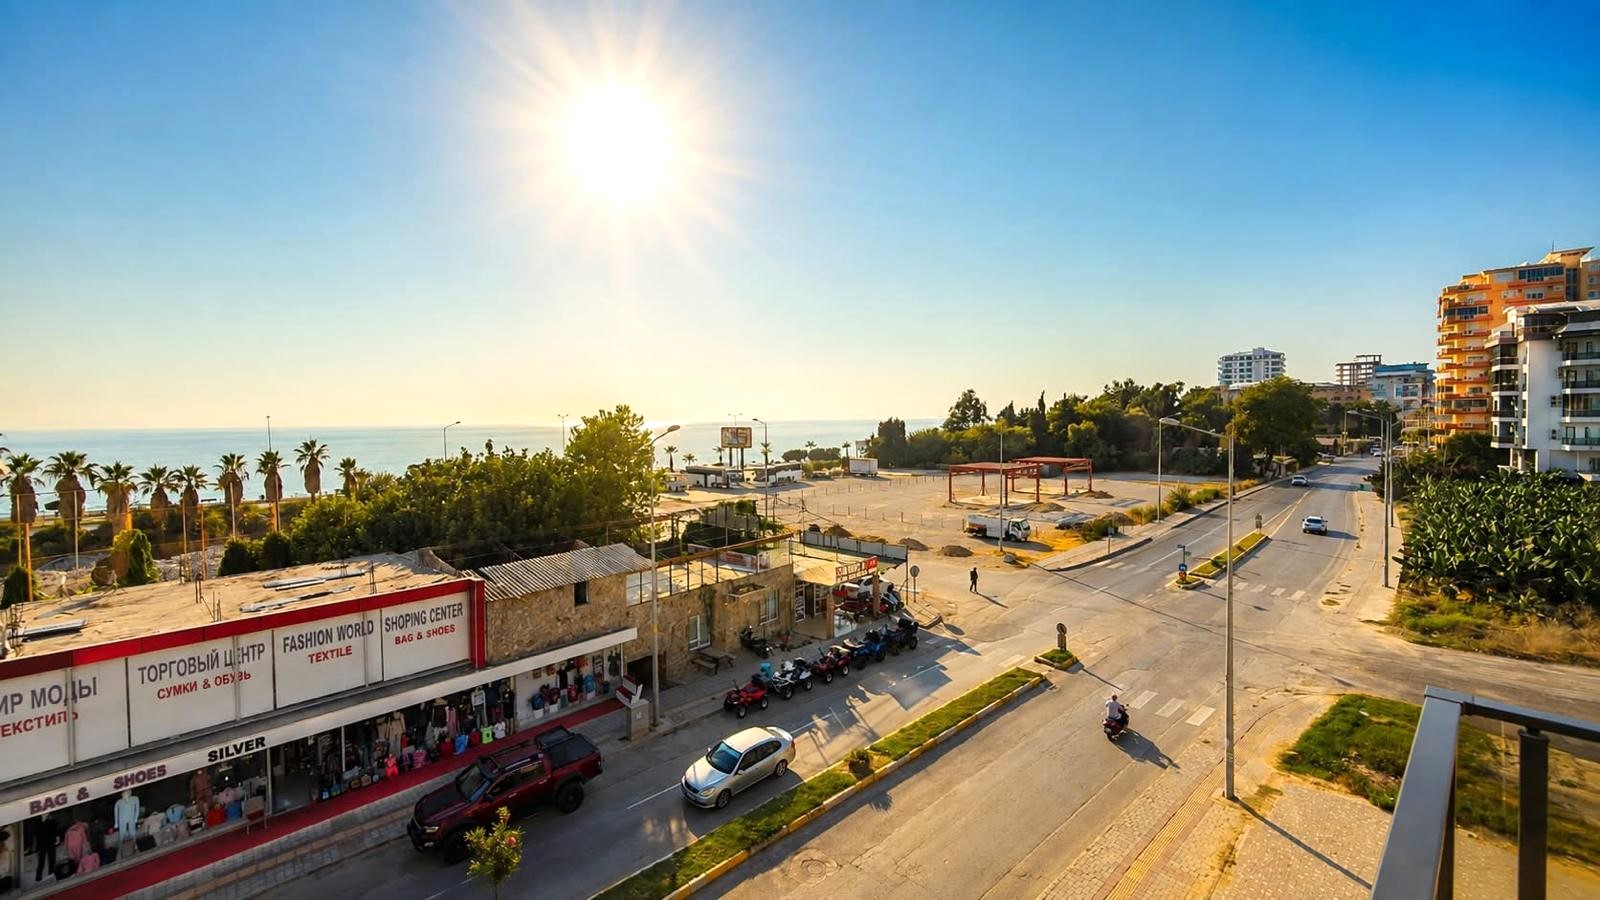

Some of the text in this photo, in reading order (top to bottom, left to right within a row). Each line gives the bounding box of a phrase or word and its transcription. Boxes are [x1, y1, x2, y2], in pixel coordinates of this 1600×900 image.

[384, 602, 464, 633] SHOPING CENTER
[283, 620, 374, 654] FASHION WORLD
[394, 624, 456, 645] BAG & SHOES
[138, 643, 266, 685] ТОРГОВЫЙ ЦЕНТР
[308, 645, 352, 664] TEXTILE
[157, 670, 252, 700] СУМКИ & ОБУВЬ
[0, 692, 23, 715] ИР
[207, 736, 266, 763] SILVER
[29, 764, 167, 815] BAG & SHOES
